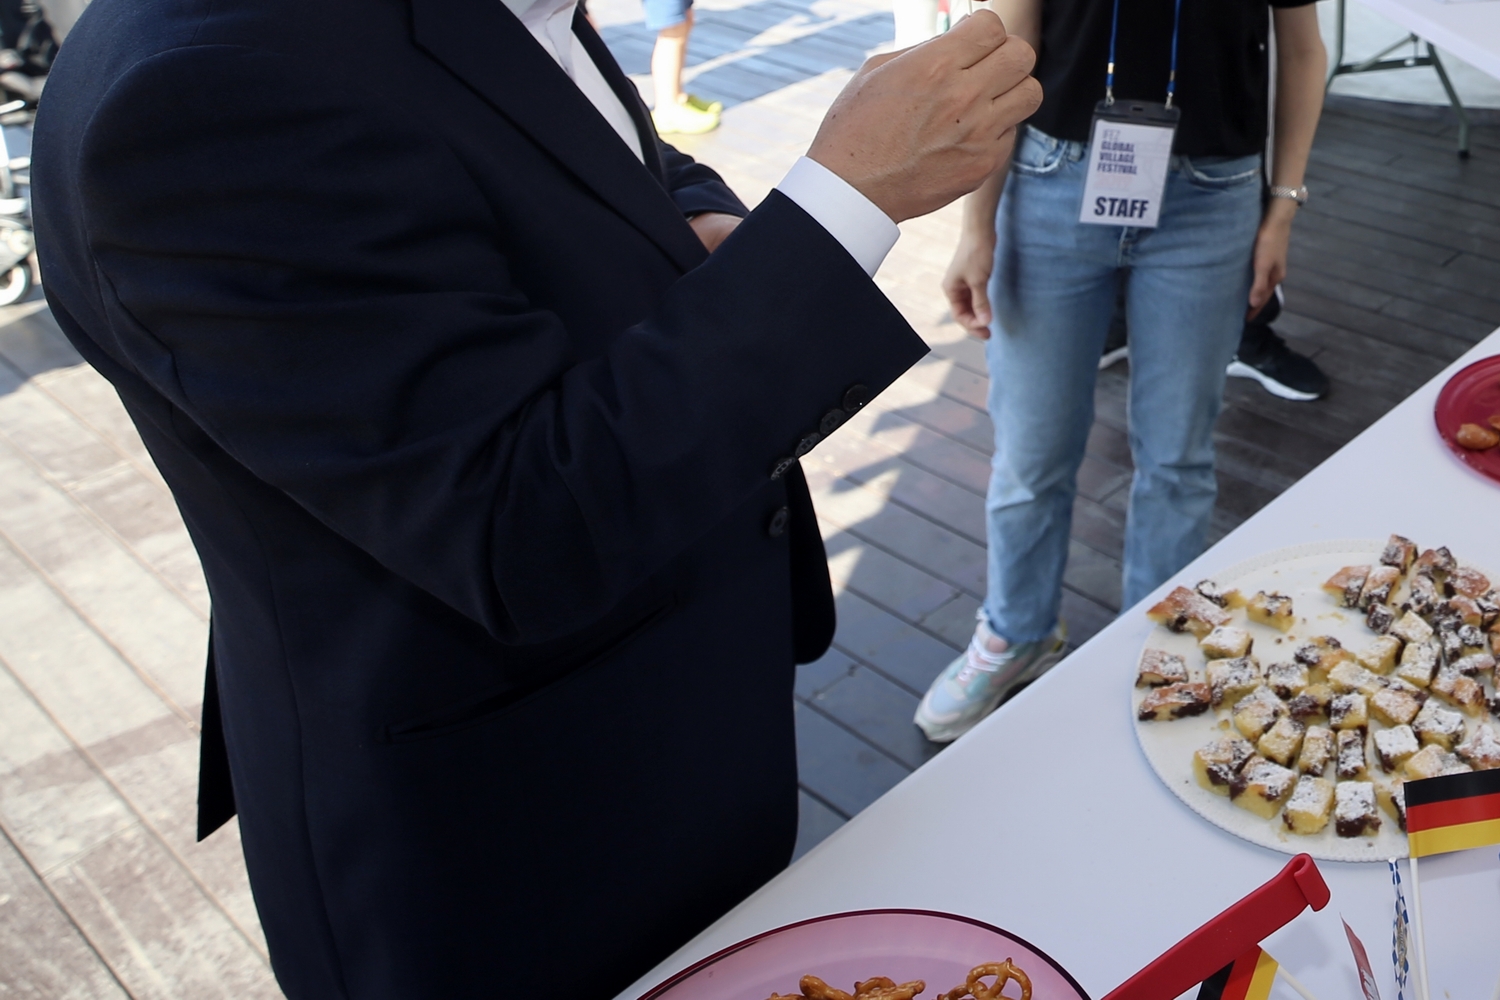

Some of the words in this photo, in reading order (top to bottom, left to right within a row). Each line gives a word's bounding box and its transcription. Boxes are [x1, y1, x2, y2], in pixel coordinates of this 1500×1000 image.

[1101, 141, 1134, 152] GLOBAL
[1099, 152, 1134, 163] VILLAGE
[1097, 163, 1137, 174] FESTIVAL
[1095, 196, 1149, 218] STAFF
